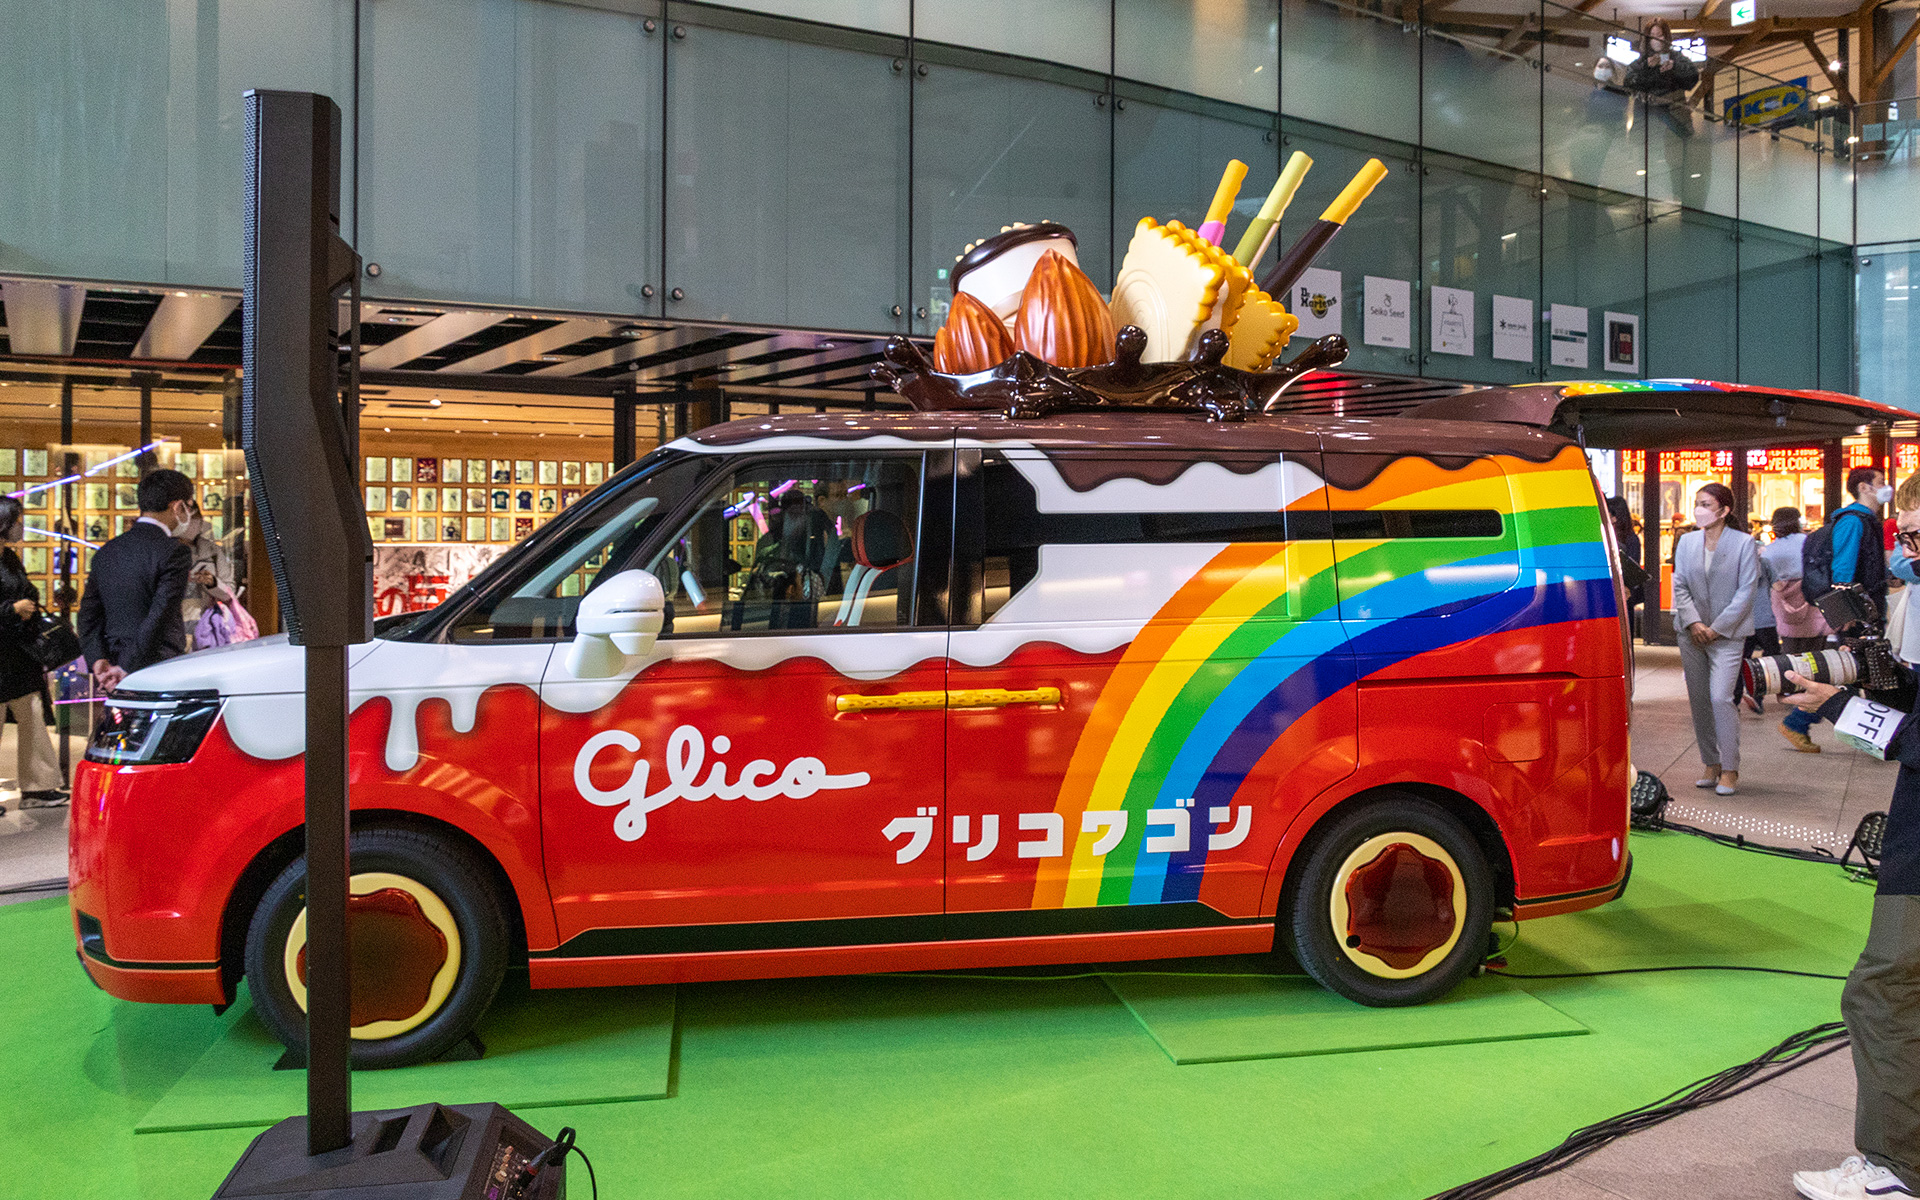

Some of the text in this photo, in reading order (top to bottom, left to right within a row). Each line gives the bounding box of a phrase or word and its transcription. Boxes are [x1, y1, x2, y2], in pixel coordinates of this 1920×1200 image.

[1732, 91, 1800, 120] IKEA
[1371, 306, 1405, 319] Seiko Seed
[573, 724, 871, 842] Glico
[881, 798, 1253, 864] グリコワゴン
